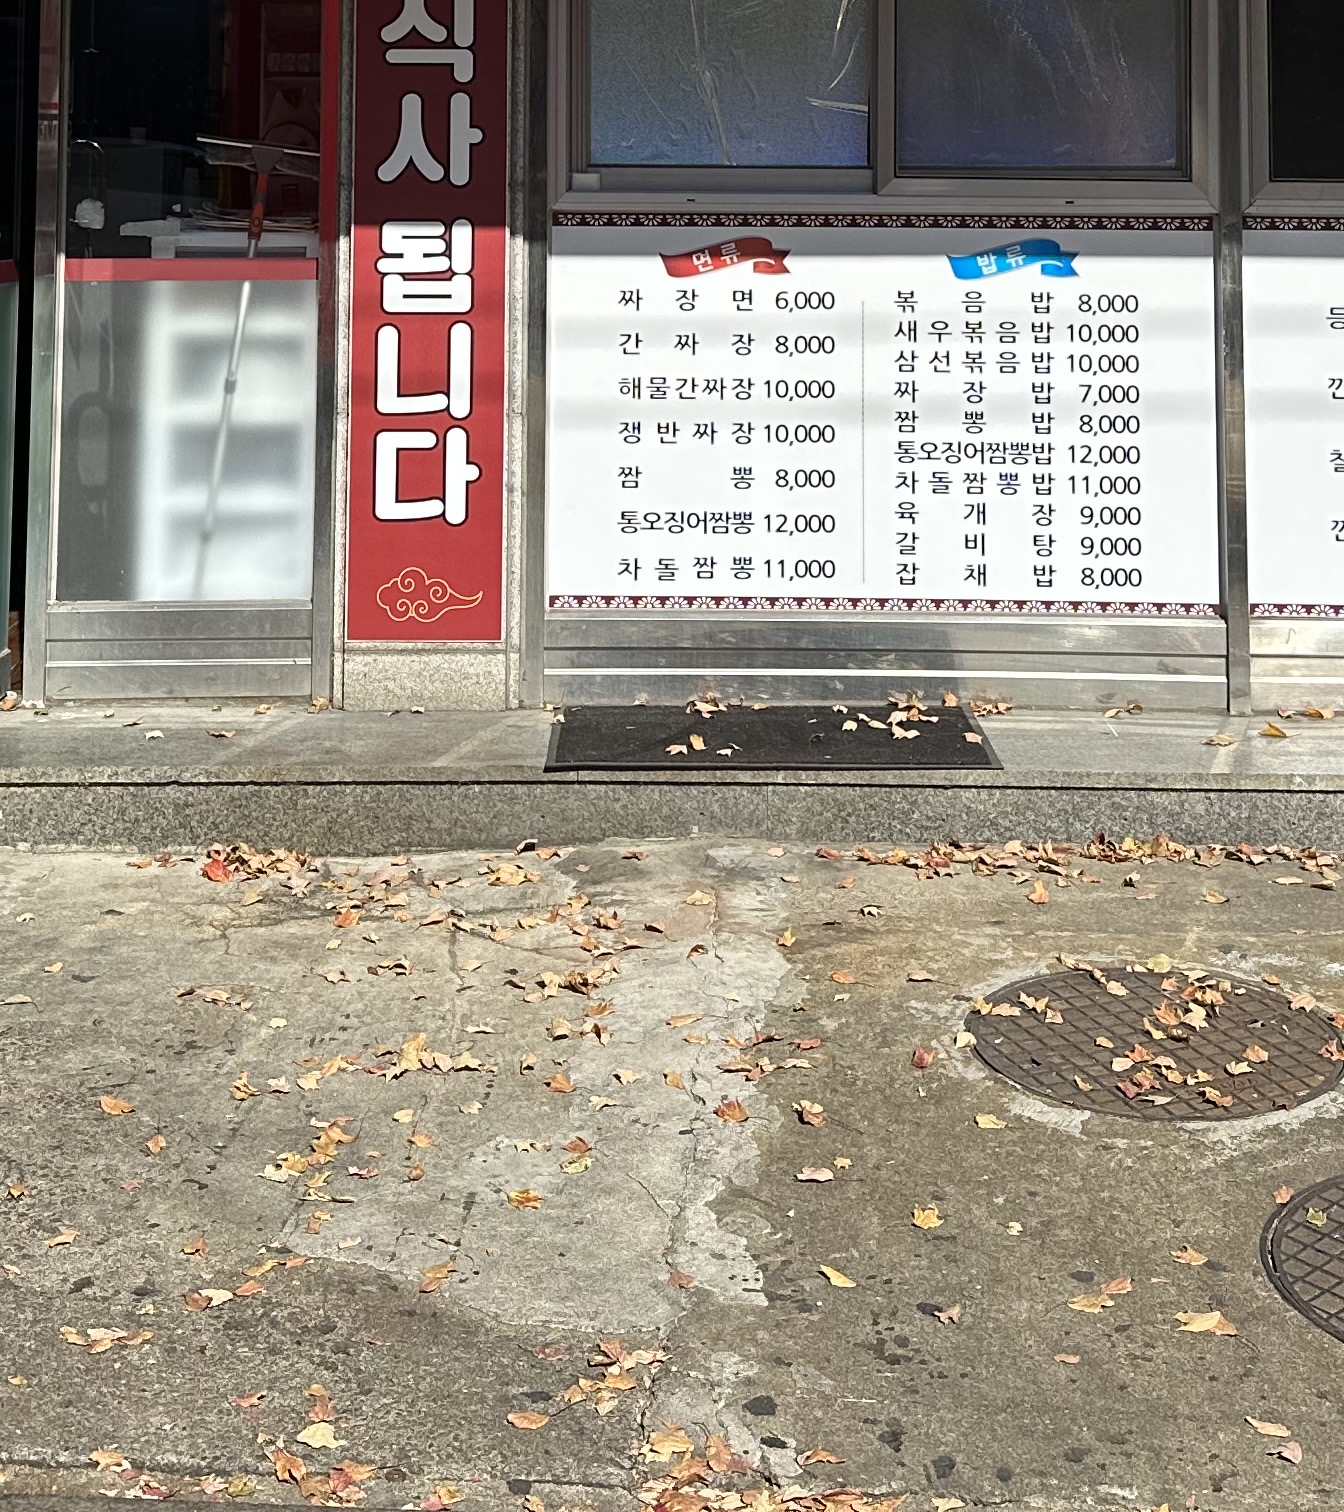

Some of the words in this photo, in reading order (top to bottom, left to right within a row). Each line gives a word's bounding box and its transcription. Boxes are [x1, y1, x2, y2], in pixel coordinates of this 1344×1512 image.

[775, 290, 836, 314] 6,000
[1077, 293, 1139, 317] 8,000
[893, 319, 1055, 345] 새우볶음밥
[1066, 323, 1140, 347] 10,000
[774, 334, 836, 358] 8,000
[373, 219, 484, 526] 됩니다
[893, 349, 1055, 375] 삼선볶음밥
[1066, 353, 1140, 377] 10,000
[617, 376, 756, 401] 해물간짜장
[763, 379, 836, 402] 10,000
[1078, 383, 1141, 407] 7,000
[763, 423, 836, 447] 10,000
[1078, 414, 1141, 437] 8,000
[893, 440, 1056, 466] 통오징어짬뽕밥
[1067, 444, 1141, 468] 12,000
[774, 468, 836, 492] 8,000
[894, 470, 1056, 496] 차돌짬뽕밥
[1067, 474, 1142, 498] 11,000
[616, 510, 756, 535] 통오징어짬뽕
[763, 513, 836, 537] 12,000
[1079, 505, 1142, 529] 9,000
[1080, 536, 1142, 560] 9,000
[763, 558, 836, 582] 11,000
[1080, 567, 1143, 590] 8,000
